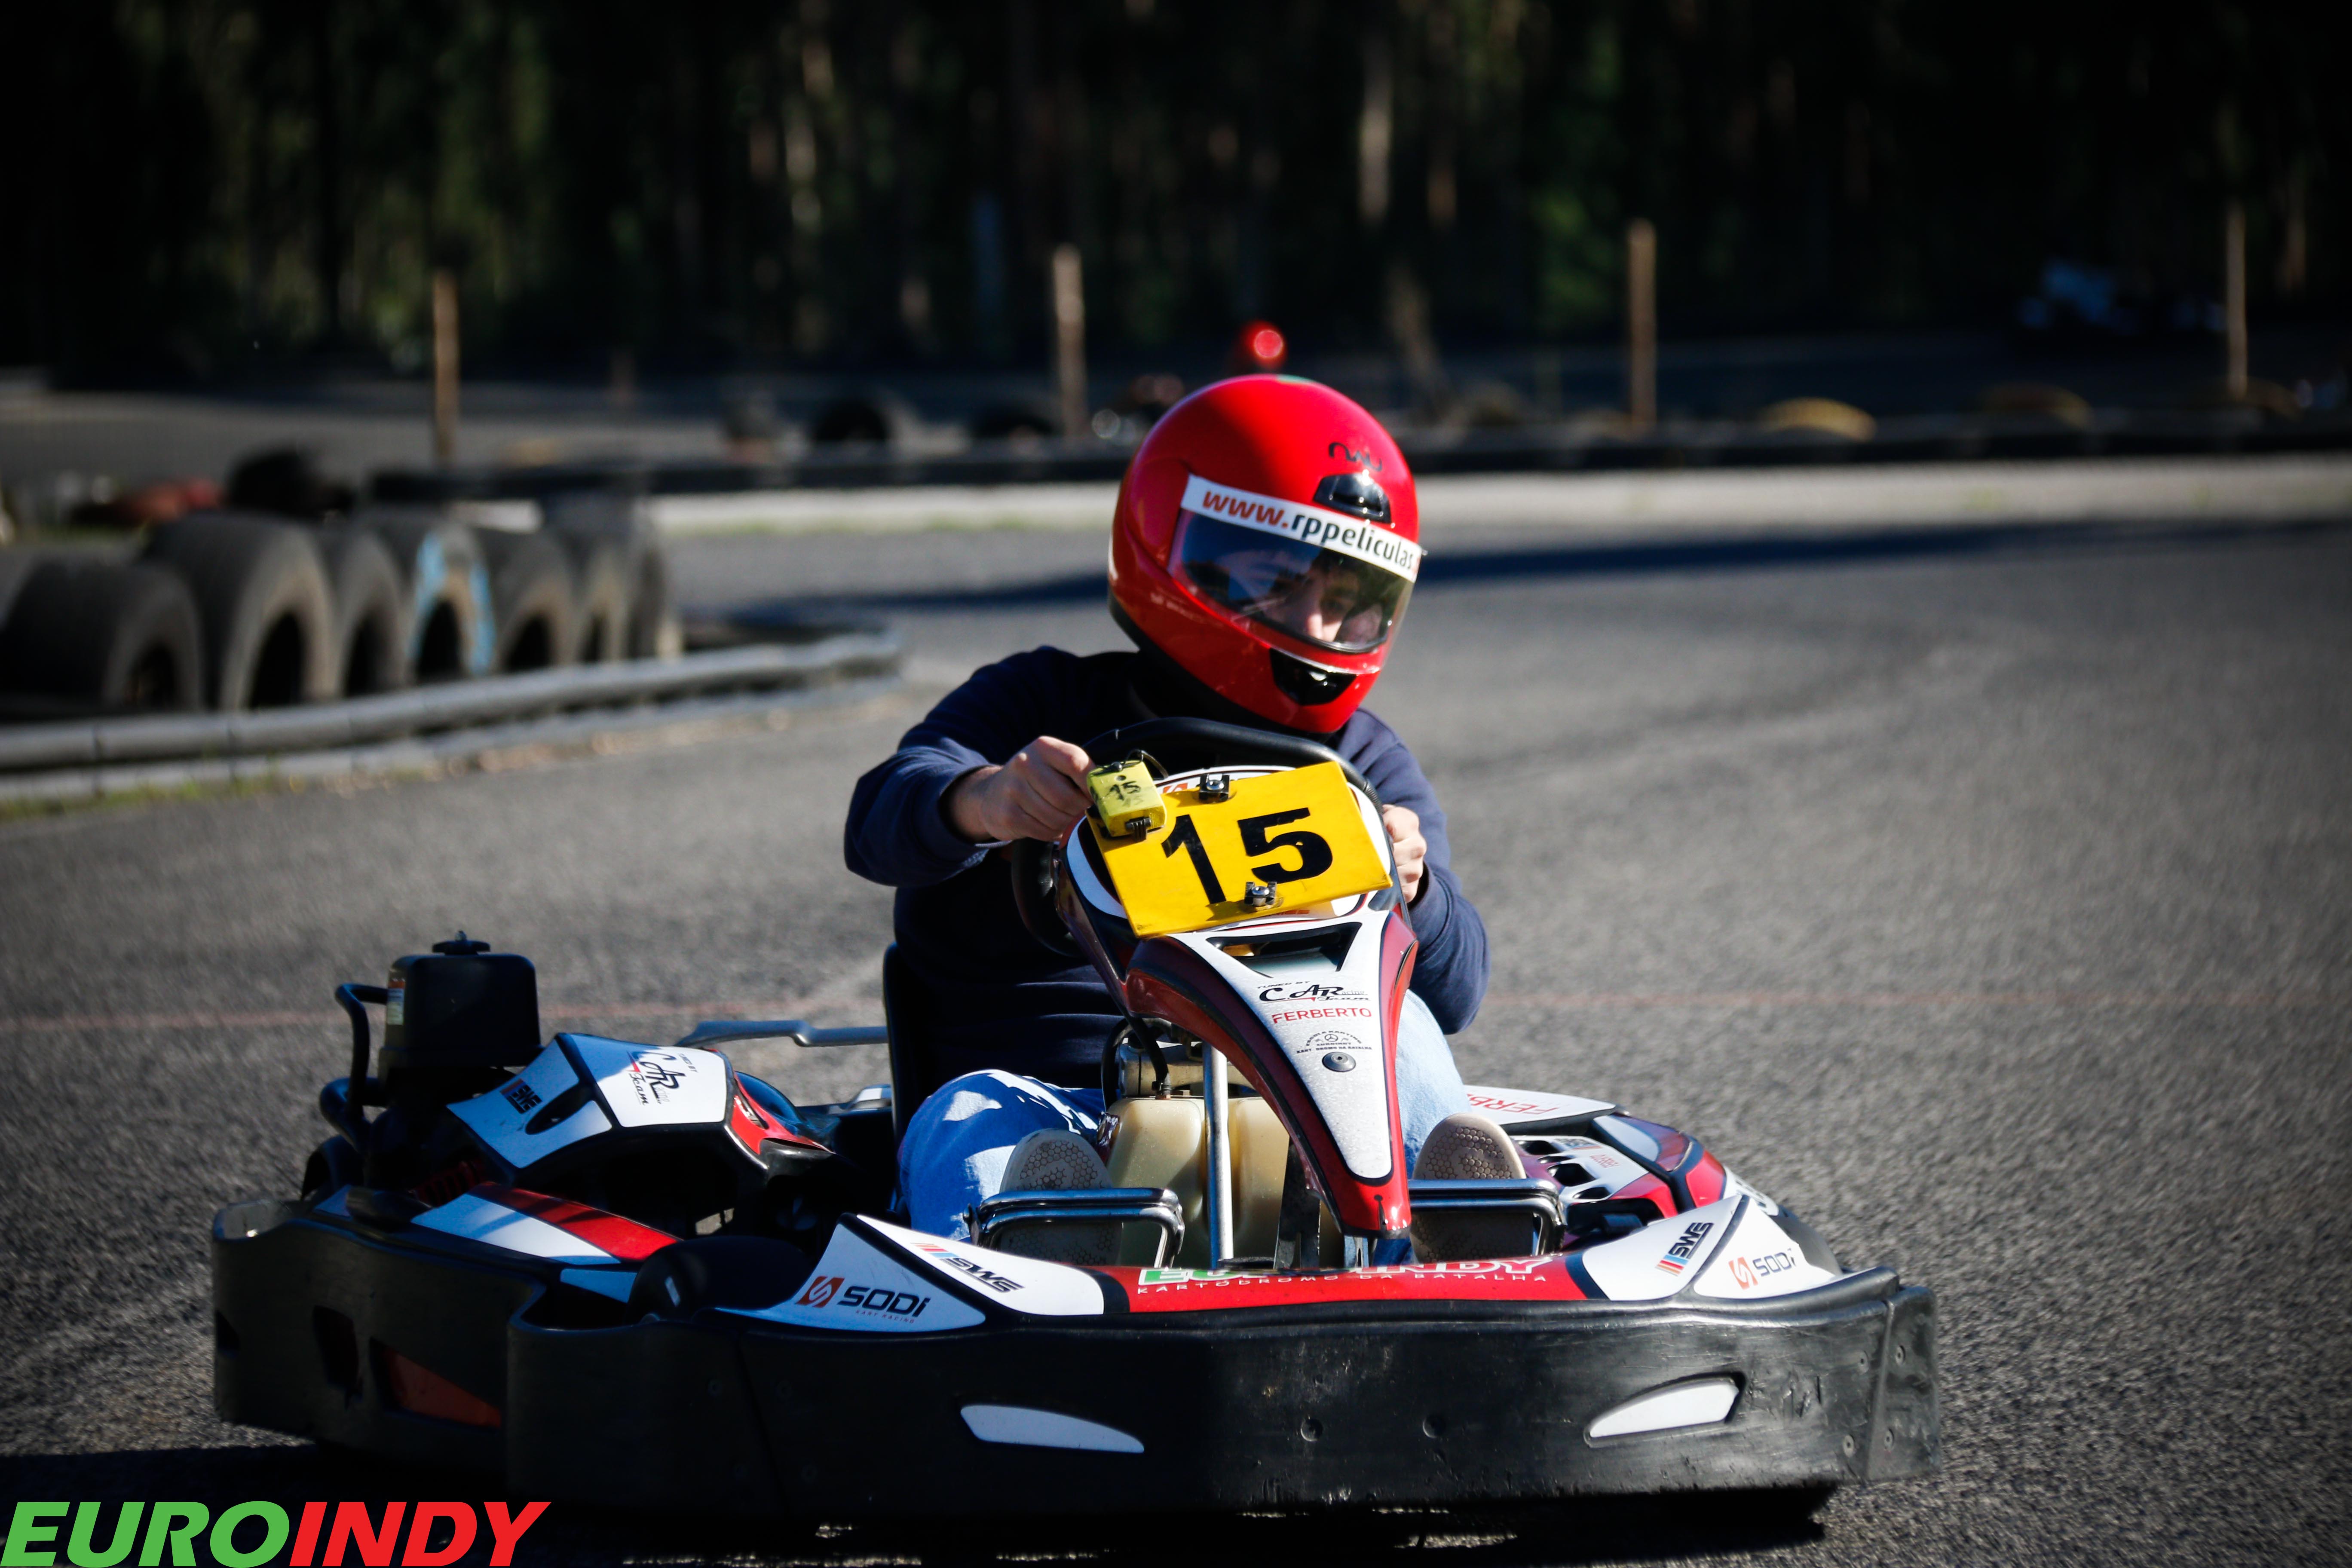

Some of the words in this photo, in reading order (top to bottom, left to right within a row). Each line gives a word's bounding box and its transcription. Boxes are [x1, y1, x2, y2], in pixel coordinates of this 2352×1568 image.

[1105, 781, 1141, 801] 15
[1162, 807, 1333, 904] 15
[1271, 1008, 1372, 1024] FERBERTO
[1467, 1093, 1560, 1115] FERB
[1668, 1222, 1715, 1259] SWS
[943, 1258, 1026, 1293] SWS
[1137, 1275, 1339, 1294] KARTODROMO
[1414, 1273, 1547, 1282] BATALHA
[836, 1286, 931, 1318] SODI
[882, 1314, 915, 1324] RACING
